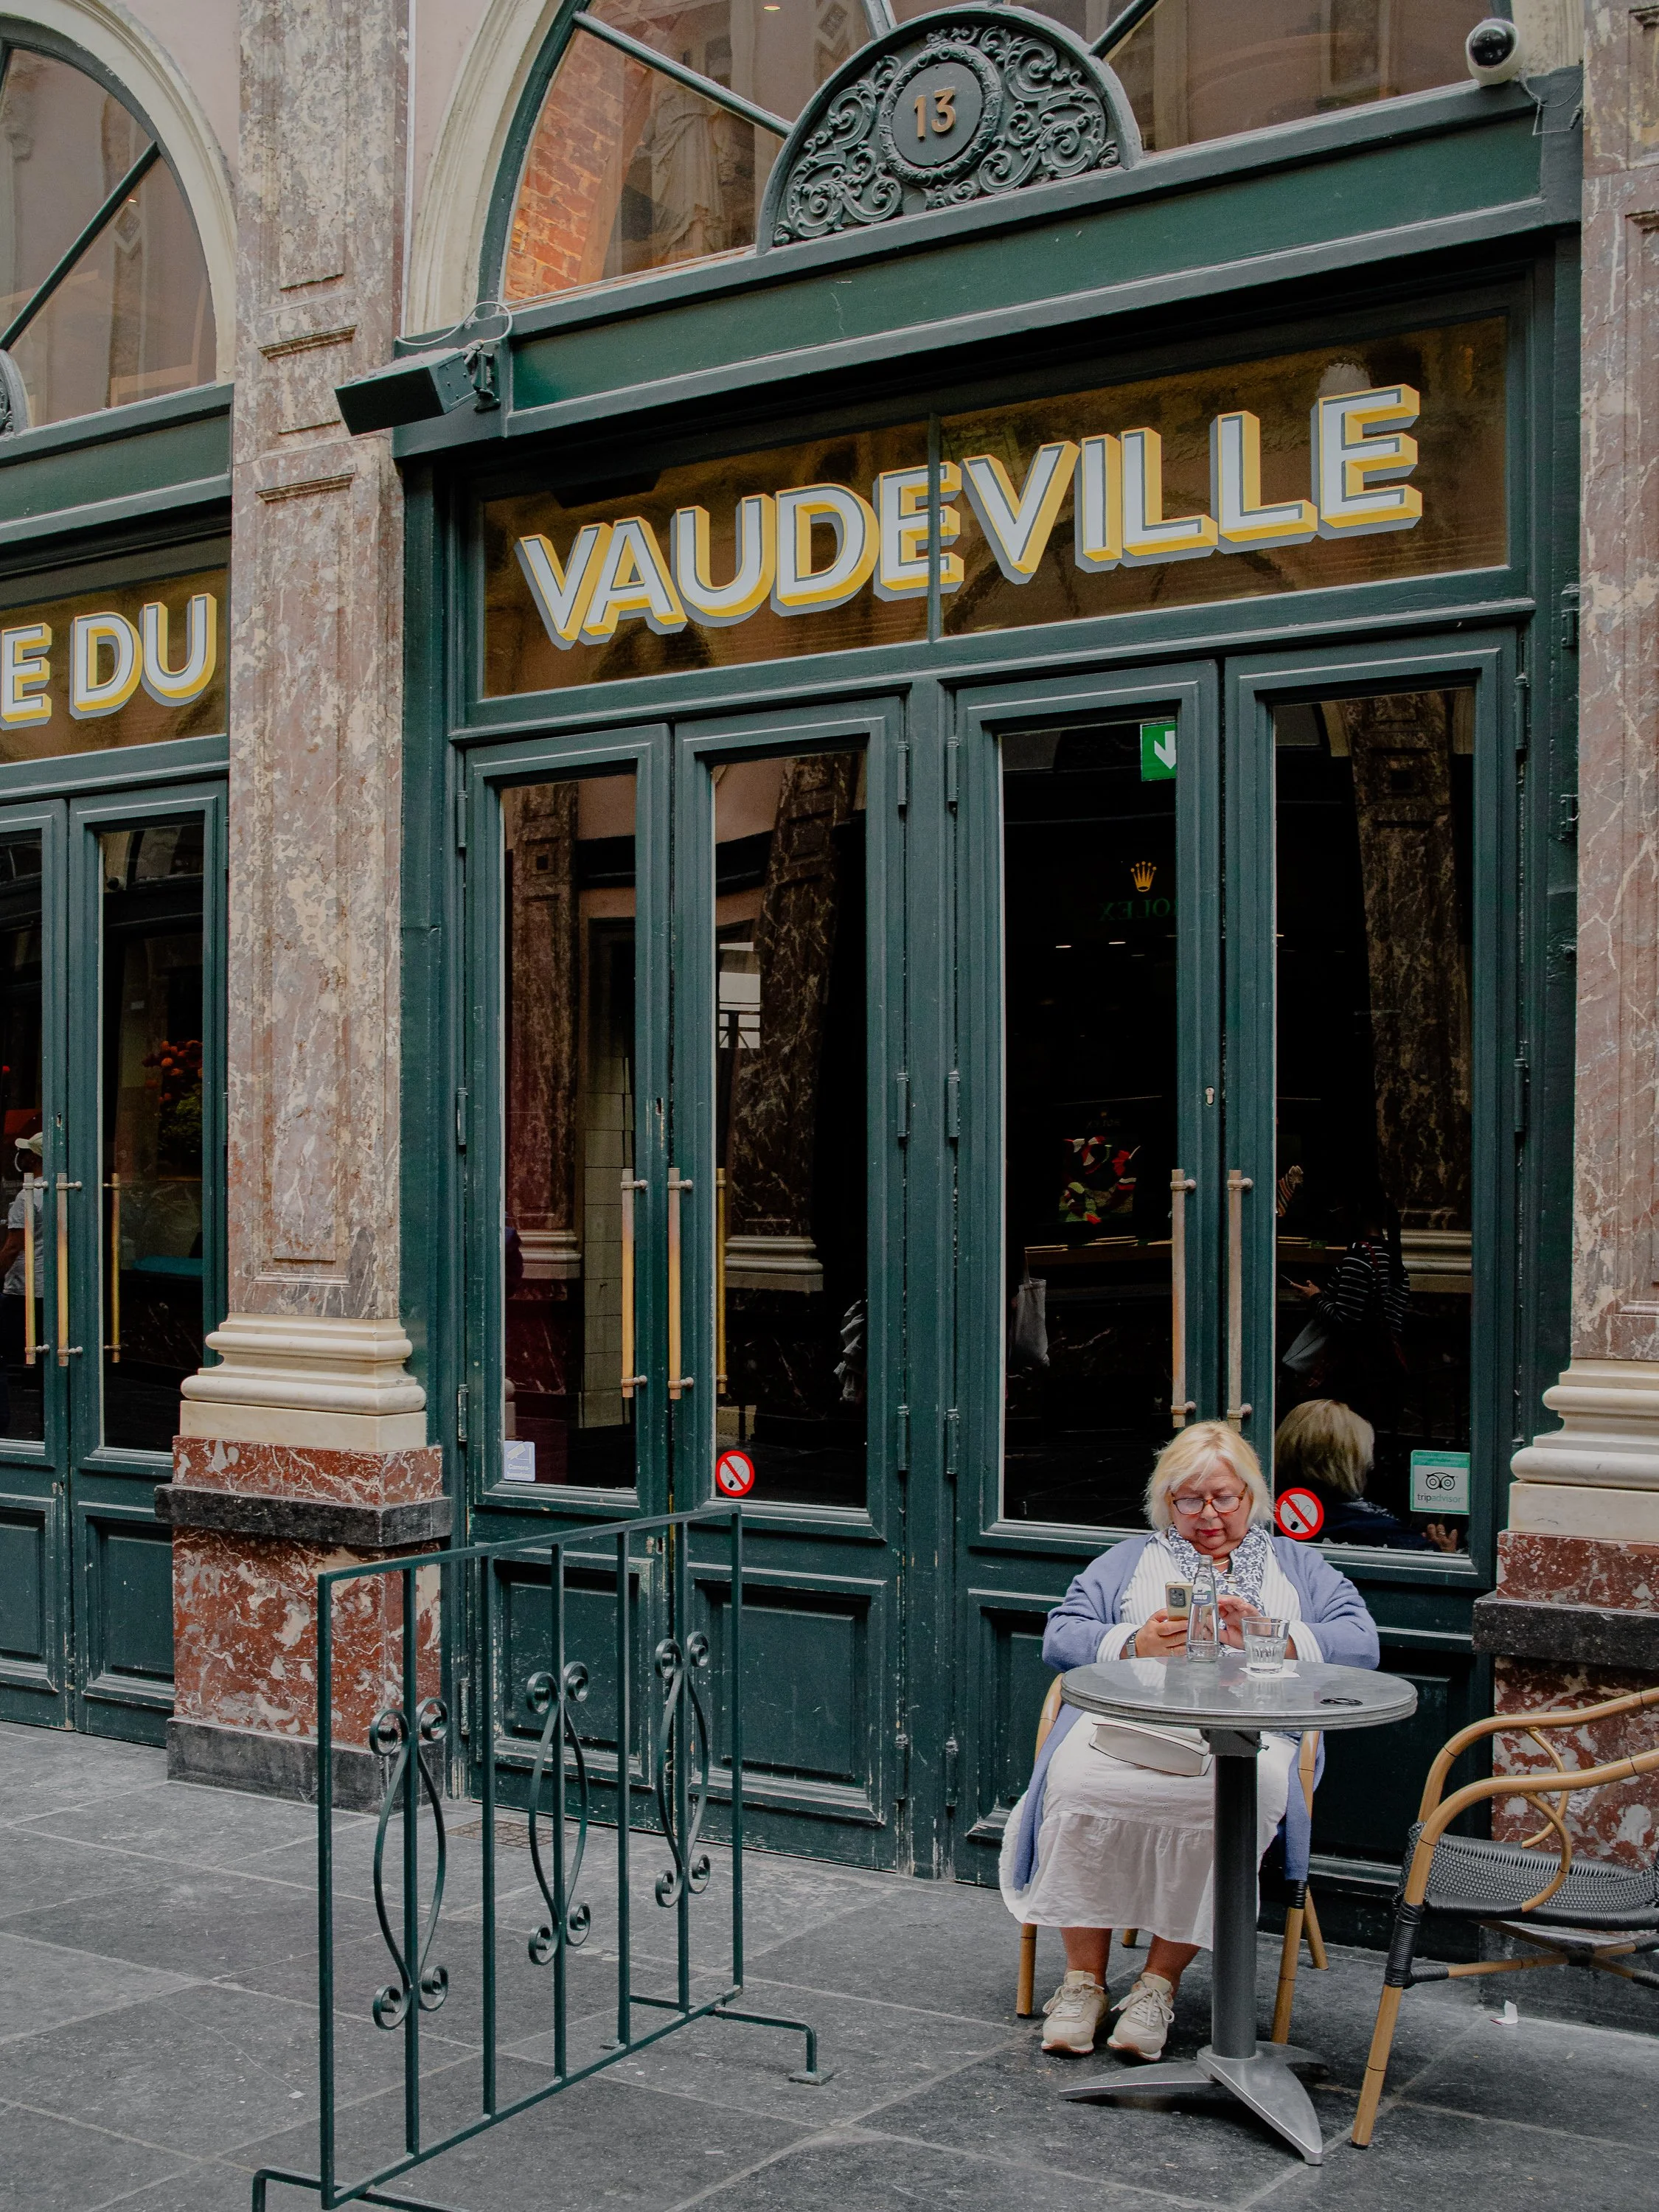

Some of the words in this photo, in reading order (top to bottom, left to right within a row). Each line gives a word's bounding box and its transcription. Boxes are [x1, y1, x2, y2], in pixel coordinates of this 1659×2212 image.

[914, 86, 956, 138] 13
[516, 383, 1422, 649] VAUDEVILLE
[69, 593, 217, 720] DU
[1417, 1493, 1463, 1503] tripadvisor
